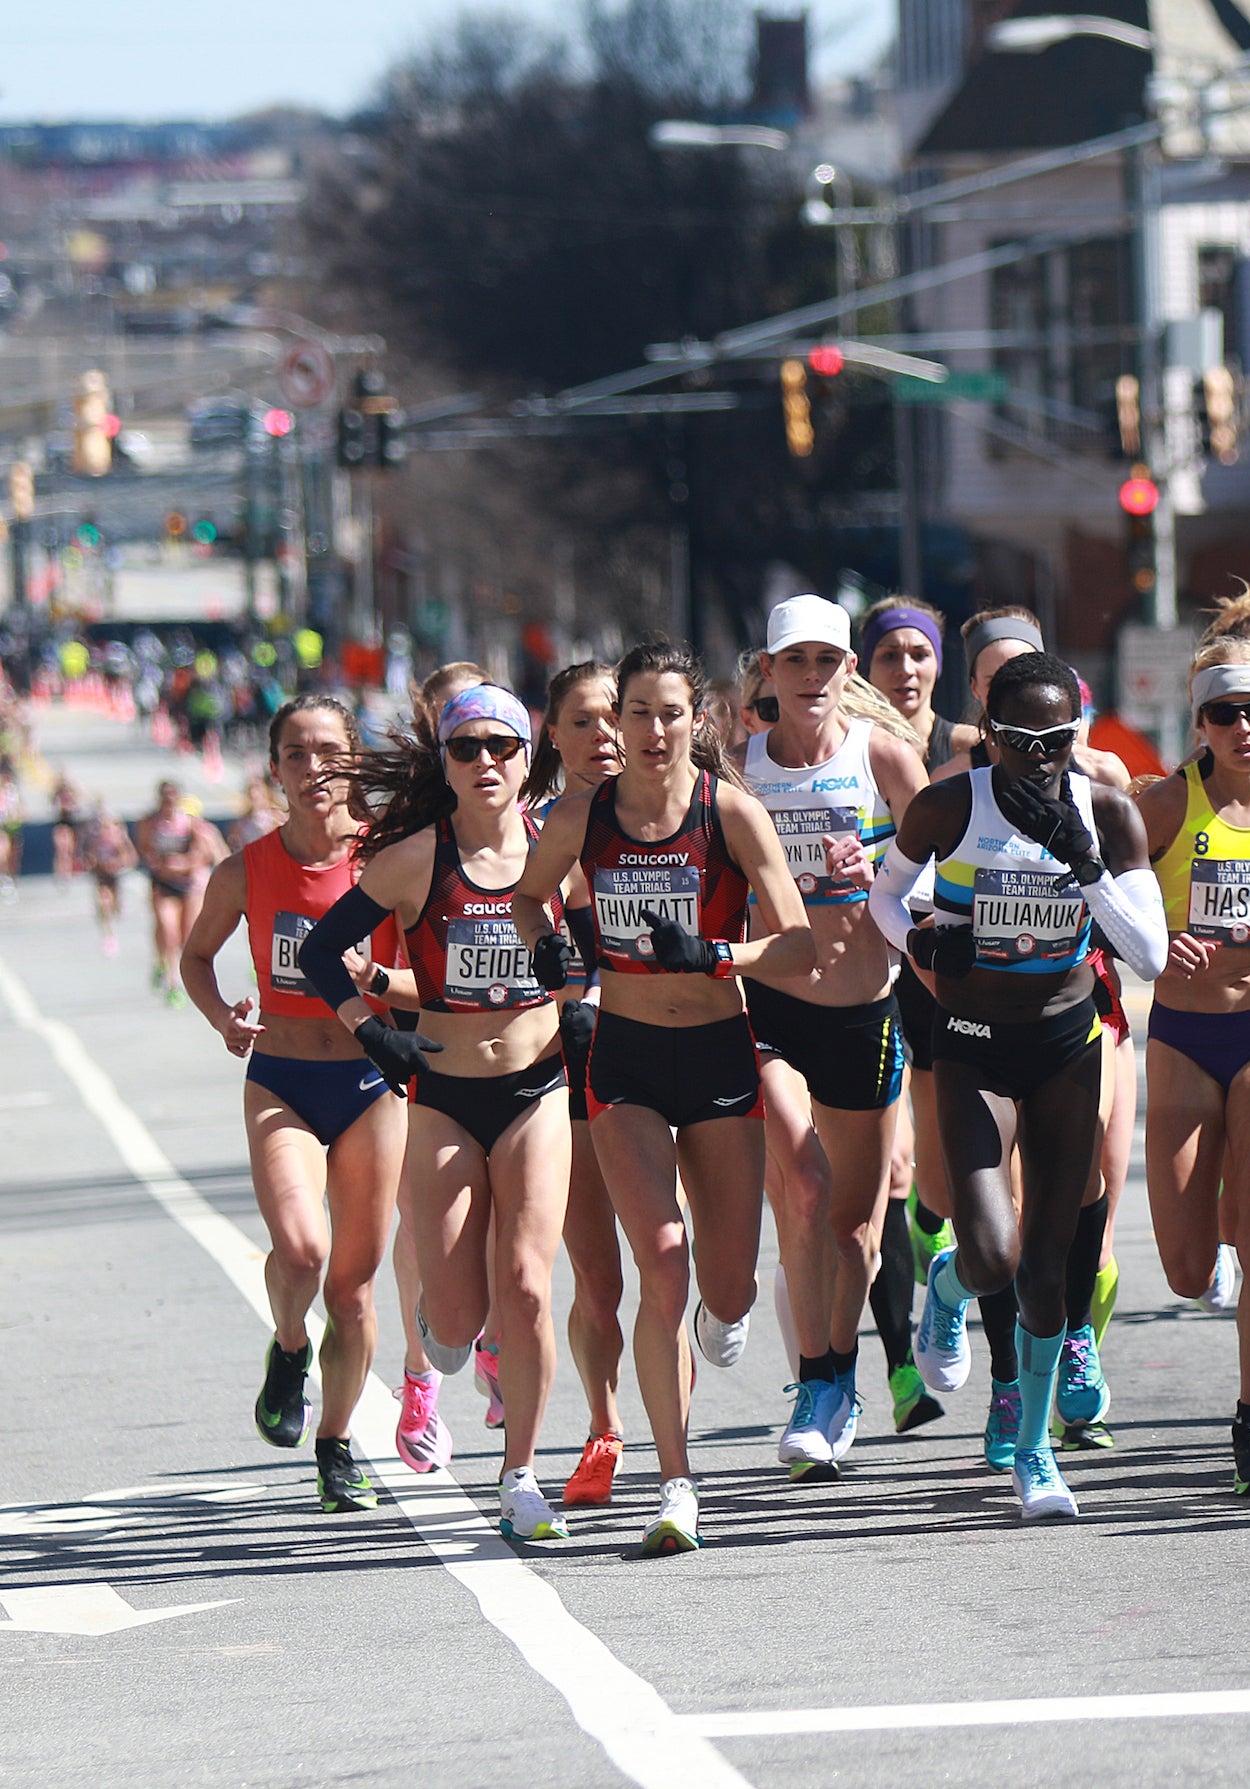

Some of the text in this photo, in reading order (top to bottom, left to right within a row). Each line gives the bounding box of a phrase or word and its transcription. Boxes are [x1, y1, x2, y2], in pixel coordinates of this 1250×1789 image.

[811, 776, 859, 793] HOKA
[775, 810, 830, 823] U.S. OLYMPIC
[776, 821, 831, 834] TEAM TRIALS
[1194, 831, 1210, 855] 8
[619, 852, 690, 866] saucony
[1217, 862, 1234, 873] U.S.
[613, 870, 671, 883] U.S. OLYMPIC
[1001, 873, 1019, 884] U.S.
[1217, 873, 1240, 884] TEAM
[614, 882, 672, 894] TEAM TRIALS
[1001, 885, 1059, 898] TEAM TRIALS
[977, 901, 1079, 929] TULIAMUK
[474, 922, 517, 934] U.S. OLYM
[474, 934, 497, 945] TEAM
[947, 1016, 992, 1039] HOKA
